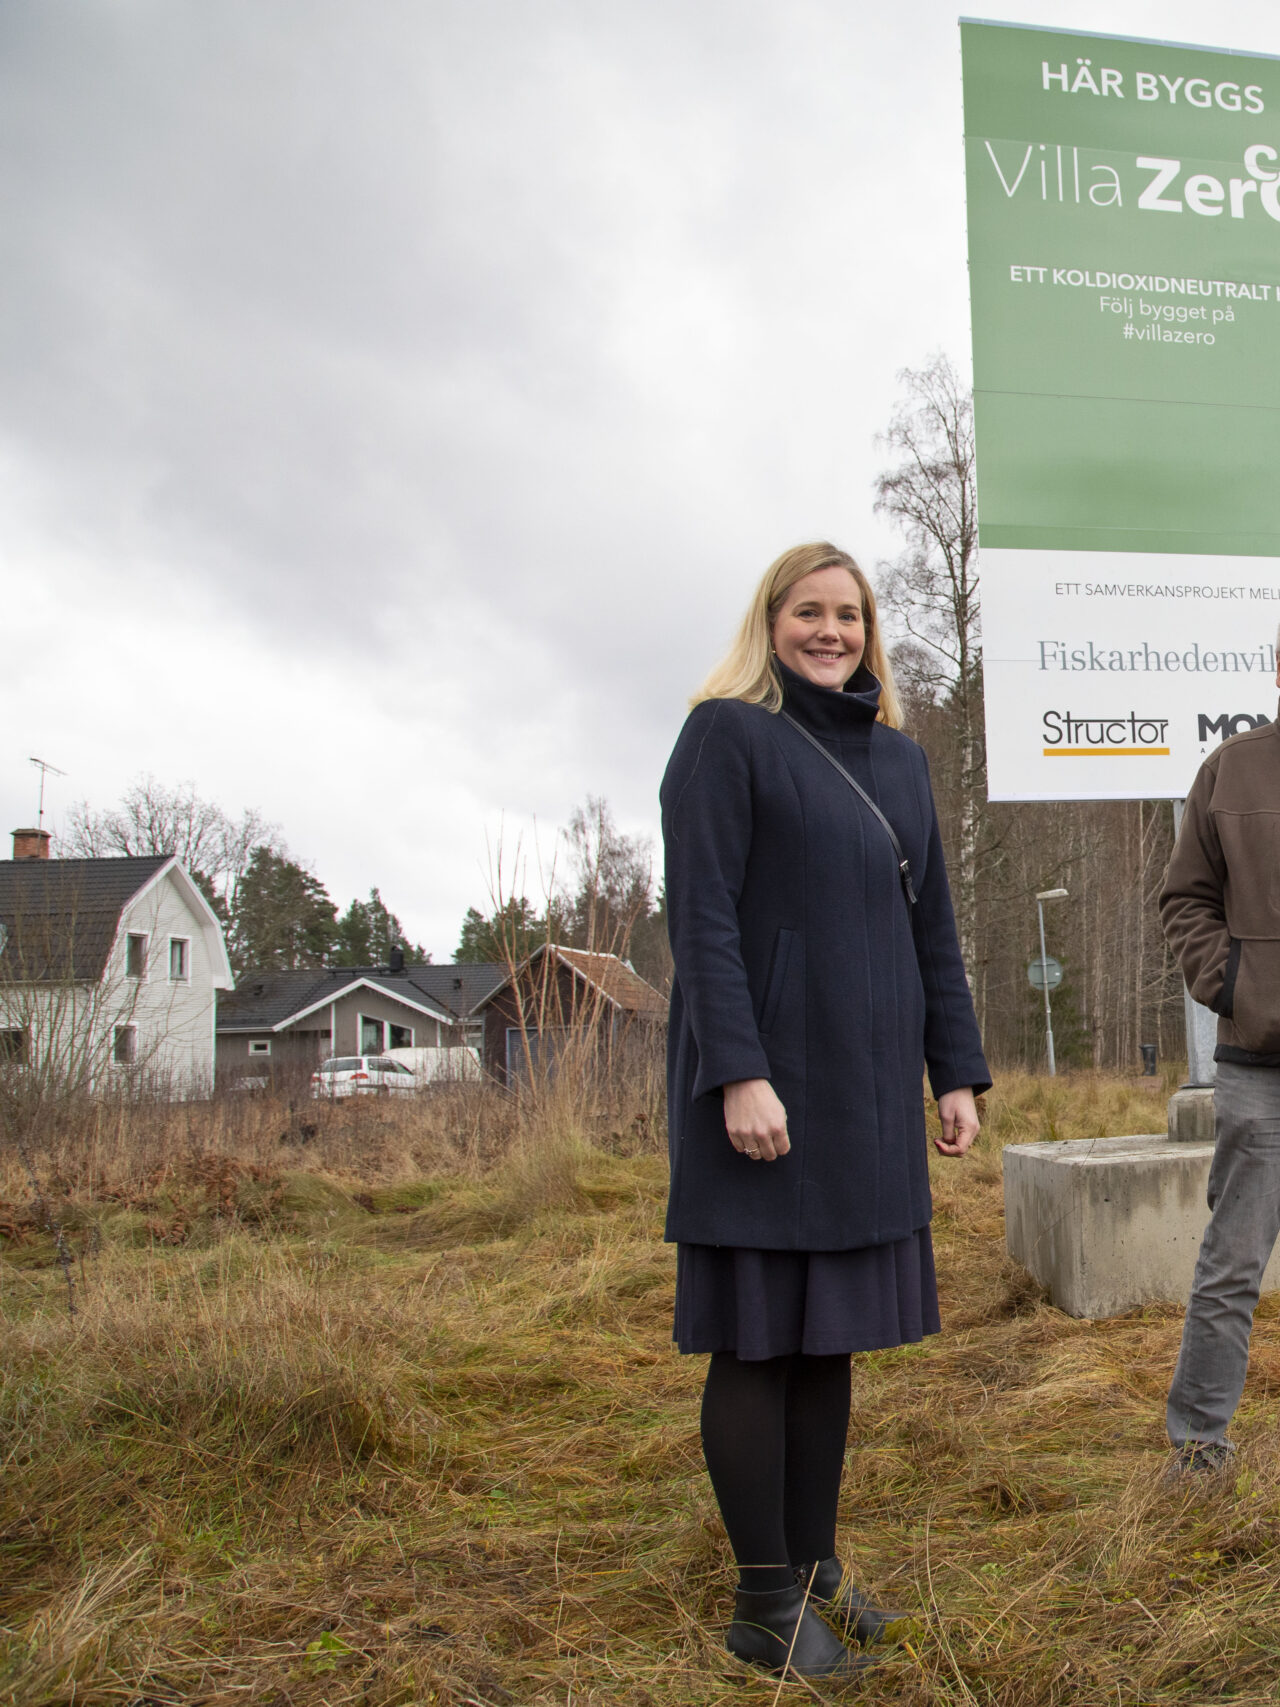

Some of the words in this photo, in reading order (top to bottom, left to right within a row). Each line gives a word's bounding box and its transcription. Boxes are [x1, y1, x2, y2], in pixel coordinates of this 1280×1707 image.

[1042, 58, 1124, 97] HÄR
[1136, 72, 1264, 113] BYGGS
[985, 141, 1122, 207] Villa
[1010, 265, 1047, 283] ETT
[1053, 269, 1271, 300] KOLDIOXIDNEUTRALT
[1100, 296, 1133, 318] Följ
[1140, 298, 1207, 322] bygget
[1213, 306, 1234, 324] på
[1123, 323, 1216, 344] #villazero
[1055, 582, 1081, 595] ETT
[1085, 583, 1246, 599] SAMVERKANSPROJEKT
[1037, 640, 1277, 673] Fiskarhedenvil
[1043, 711, 1168, 744] Structor
